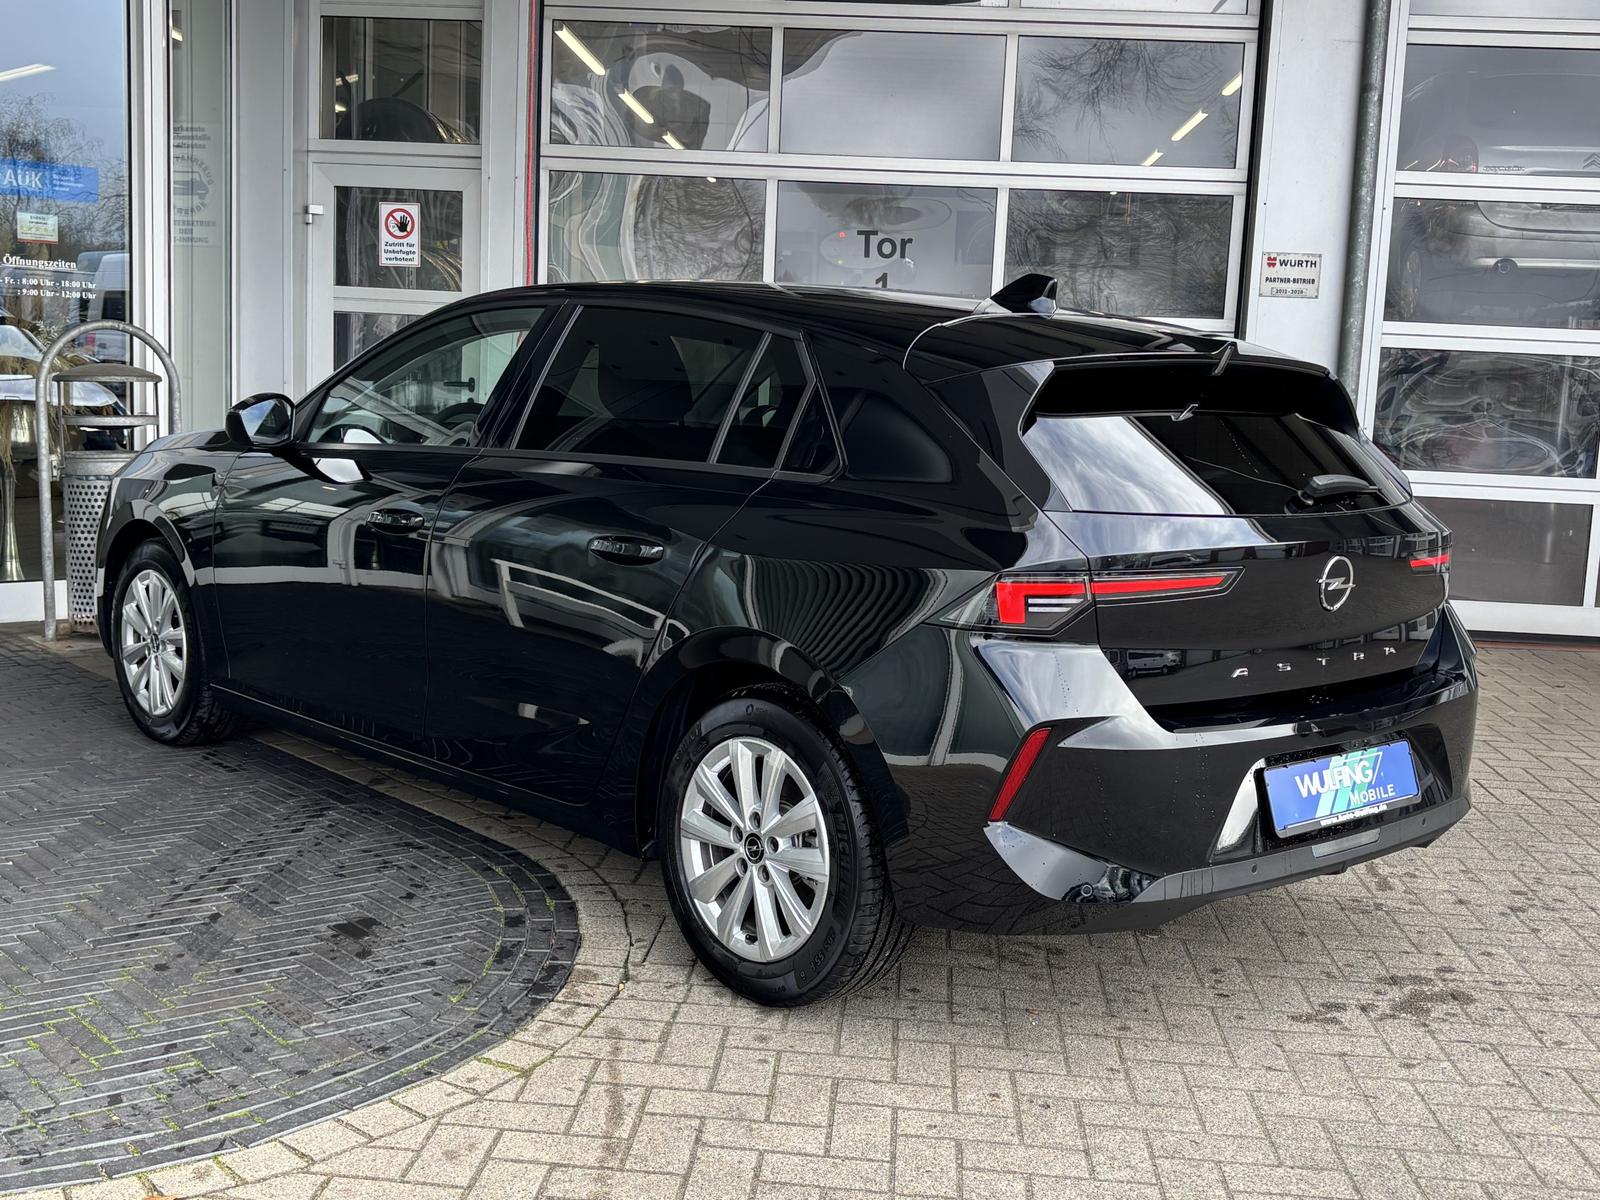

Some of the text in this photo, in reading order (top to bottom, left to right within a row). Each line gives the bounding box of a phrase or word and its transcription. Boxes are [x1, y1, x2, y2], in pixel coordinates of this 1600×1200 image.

[857, 230, 913, 259] Tor
[3, 253, 77, 269] Öffnungszeiten
[40, 278, 55, 287] Uhr
[61, 280, 80, 288] 18:00
[82, 281, 97, 289] Uhr
[875, 272, 888, 288] 1
[22, 288, 39, 296] 9:00
[40, 289, 55, 297] Uhr
[61, 290, 80, 298] 12:00
[82, 291, 97, 299] Uhr
[1231, 647, 1397, 678] ASTRA
[1350, 784, 1396, 806] MOBILE
